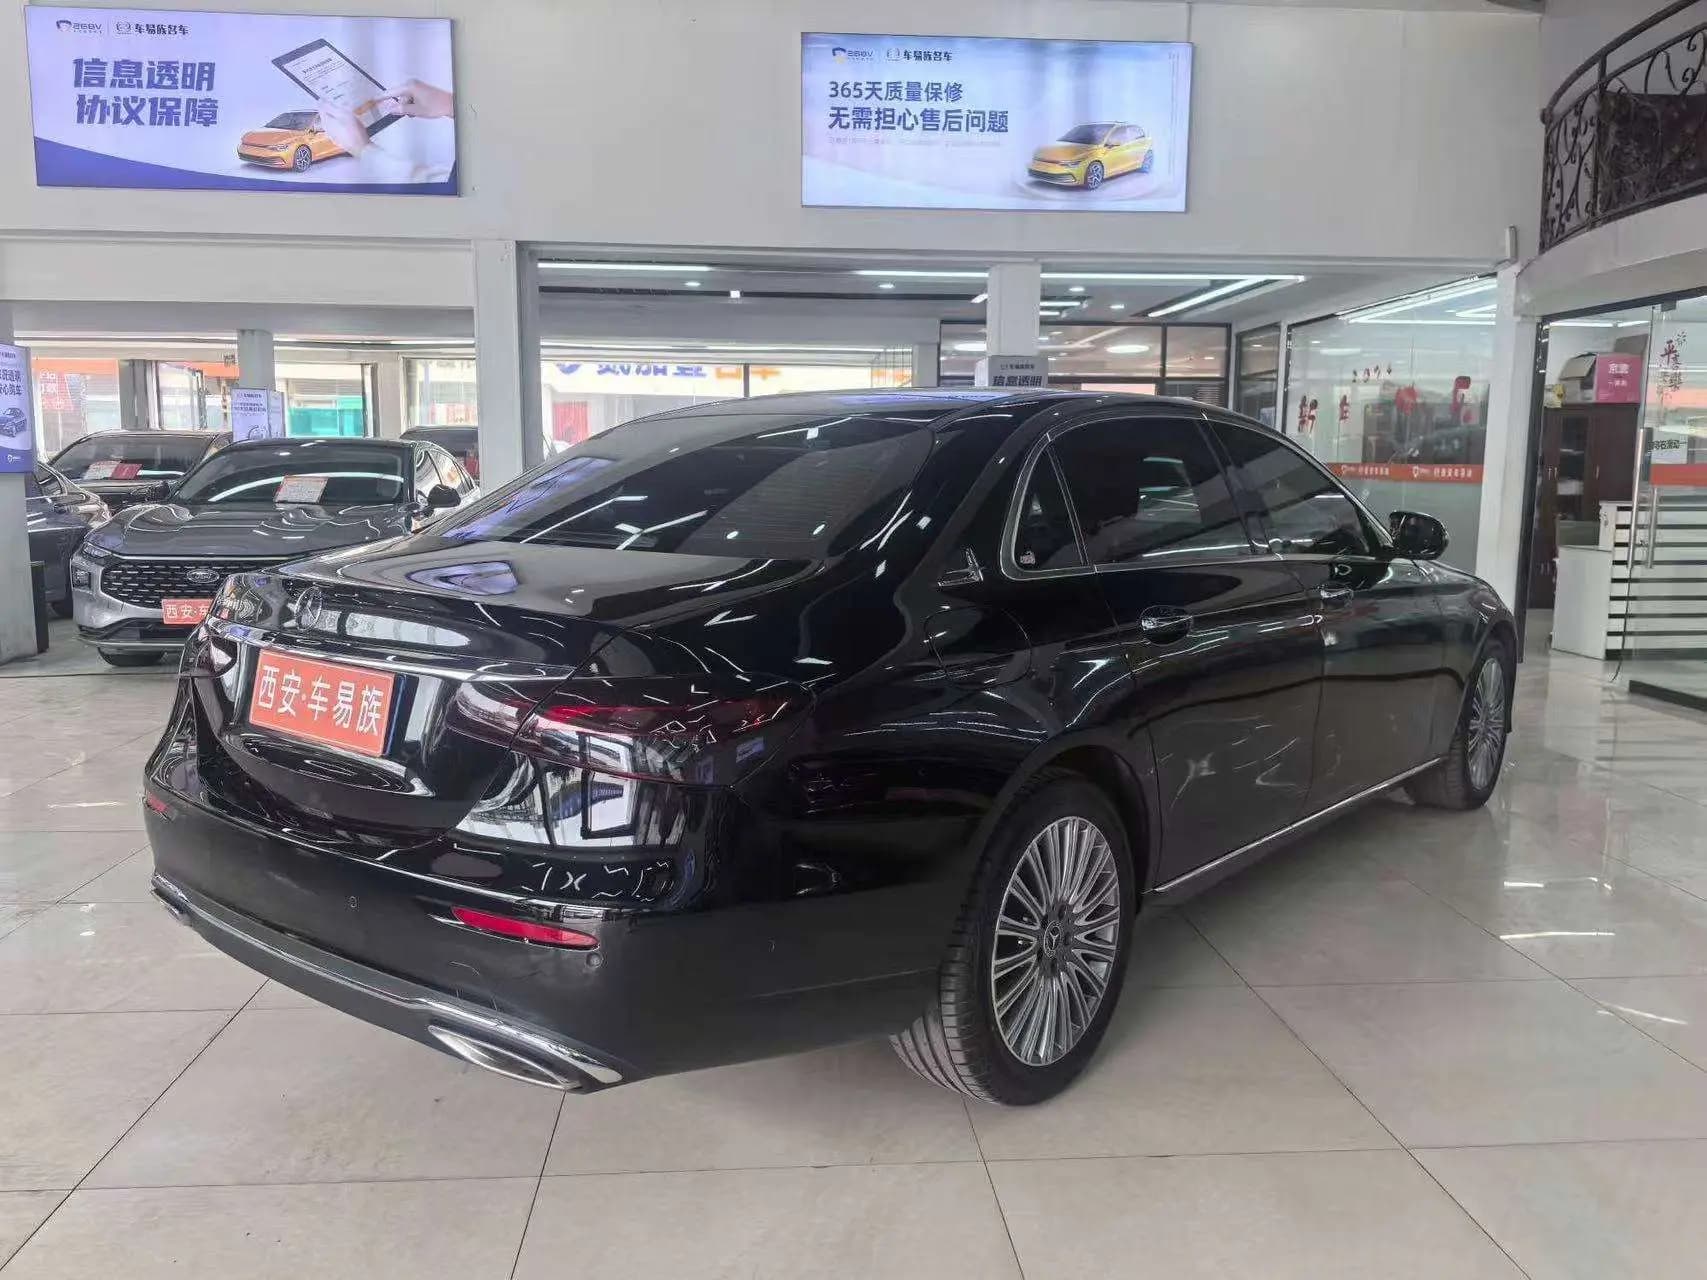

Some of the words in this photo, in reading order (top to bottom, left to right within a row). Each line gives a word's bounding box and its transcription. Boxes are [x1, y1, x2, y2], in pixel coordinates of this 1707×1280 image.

[73, 57, 216, 92] 信息透明
[828, 80, 963, 102] 365天质量保修
[75, 94, 218, 127] 协议保障
[828, 106, 1009, 133] 无需担心售后问题
[992, 374, 1043, 387] 信息透明
